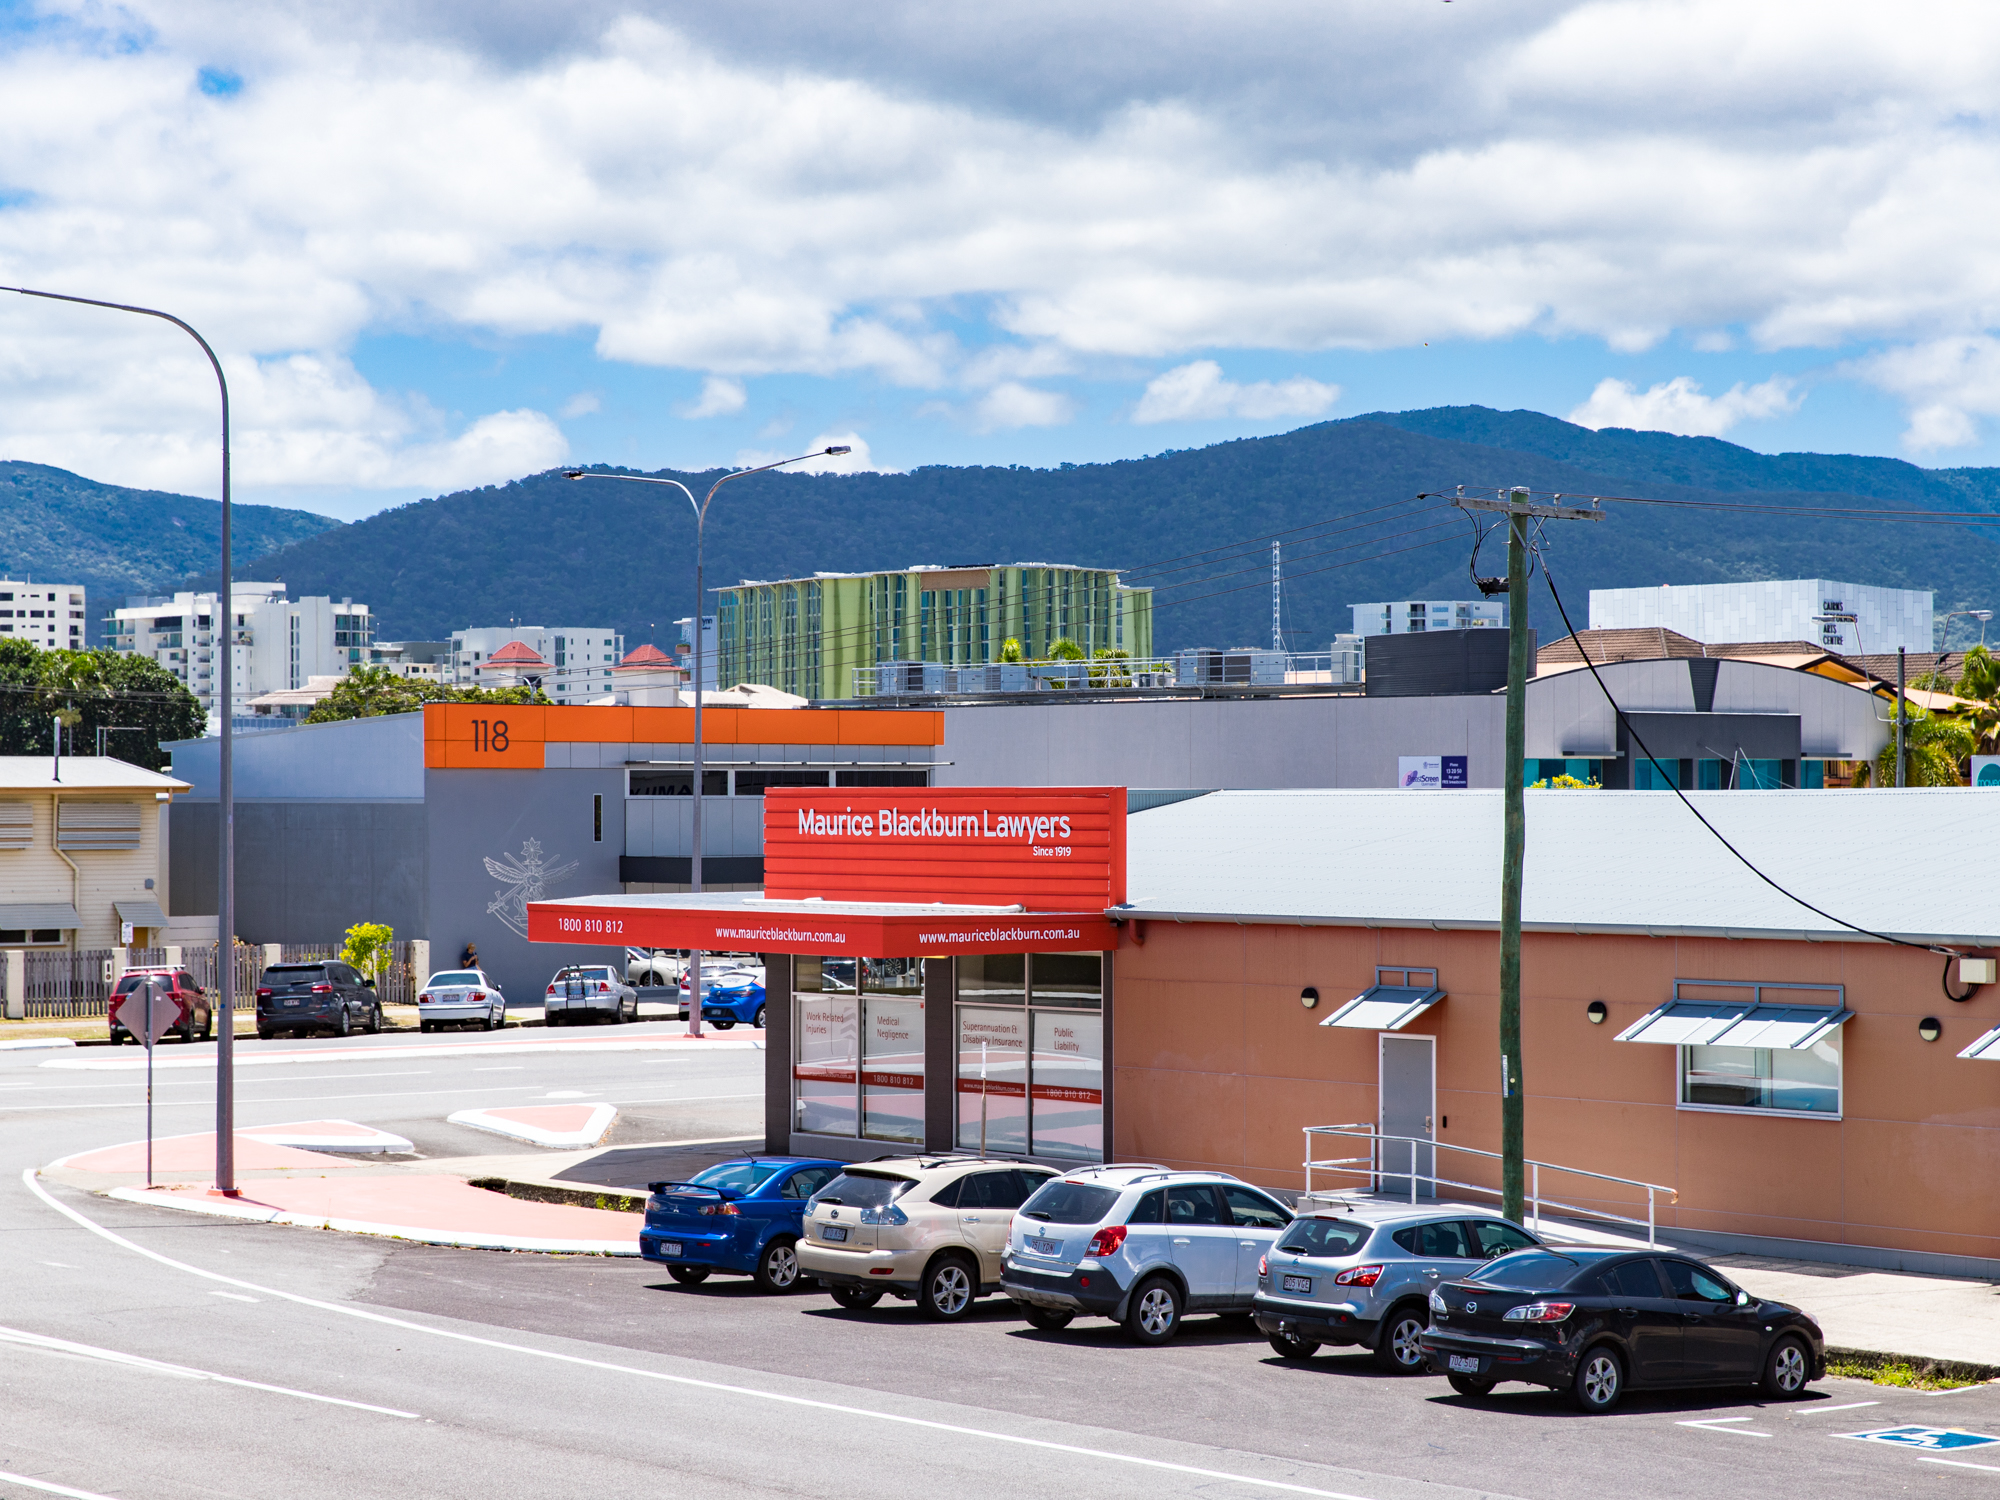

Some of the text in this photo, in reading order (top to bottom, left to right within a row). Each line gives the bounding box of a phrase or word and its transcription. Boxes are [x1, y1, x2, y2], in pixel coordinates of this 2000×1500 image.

[1823, 601, 1843, 611] CAIRNS
[1823, 624, 1836, 634] ARTS
[1823, 635, 1843, 645] CENTRE
[471, 720, 509, 752] 118
[799, 806, 1071, 844] Maurice Blackburn Lawyers
[1032, 846, 1071, 857] Since 1919
[558, 918, 623, 934] 1800 810 812
[716, 926, 846, 943] www.mauriceblackburn.com.au
[919, 927, 1080, 943] www.mauriceblackburn.com.au
[806, 1012, 844, 1023] Work Related
[877, 1016, 899, 1026] Medical
[806, 1024, 827, 1035] Injuries
[962, 1021, 1017, 1034] Superannuation &
[1054, 1028, 1073, 1038] Public
[877, 1029, 909, 1040] Negligence
[962, 1035, 1022, 1047] Disability Insurance
[1054, 1041, 1079, 1052] Liability
[873, 1075, 914, 1085] 1800 810 812
[1046, 1089, 1091, 1099] 1800 810 812
